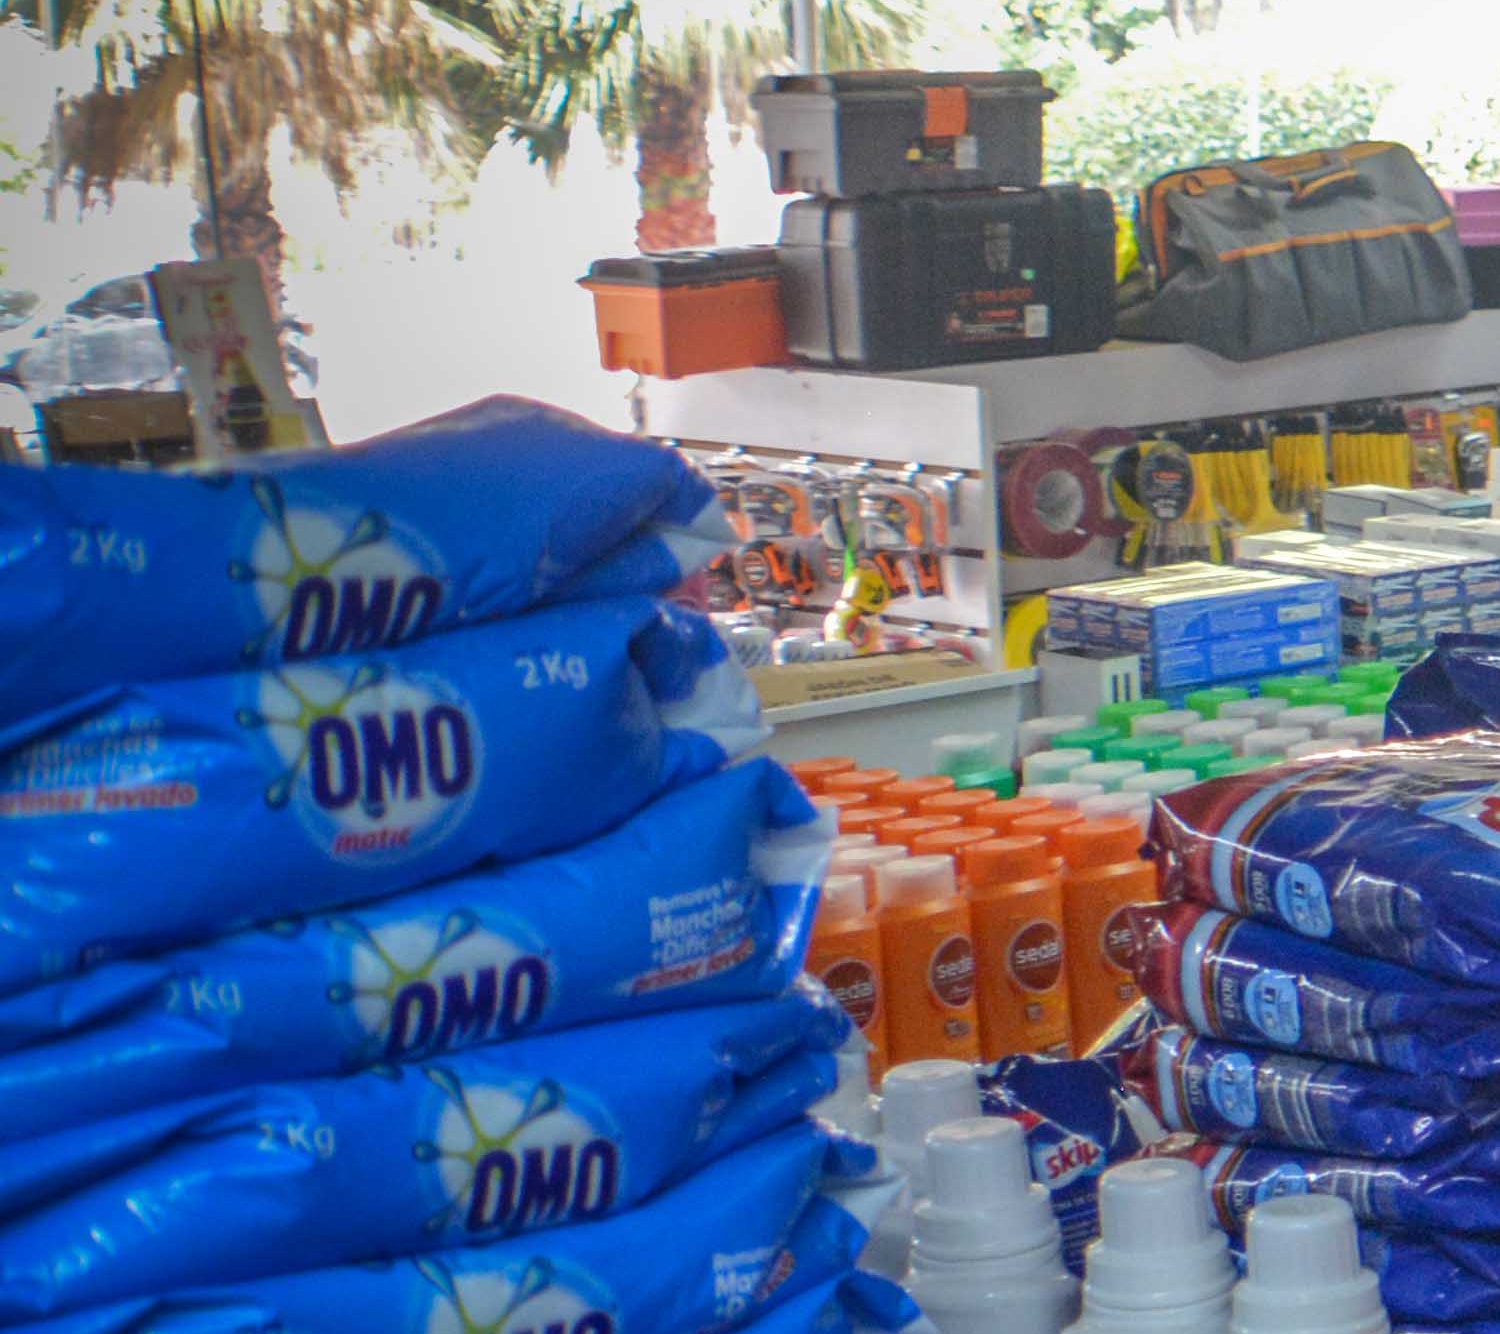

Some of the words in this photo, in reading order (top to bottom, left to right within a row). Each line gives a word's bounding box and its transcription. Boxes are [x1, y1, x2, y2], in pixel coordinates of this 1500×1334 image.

[281, 574, 443, 661] OMO
[309, 707, 477, 809] OMO
[1014, 941, 1059, 965] seda
[386, 951, 551, 1065] OMO
[466, 1140, 619, 1234] OMO
[1043, 1137, 1102, 1181] skip
